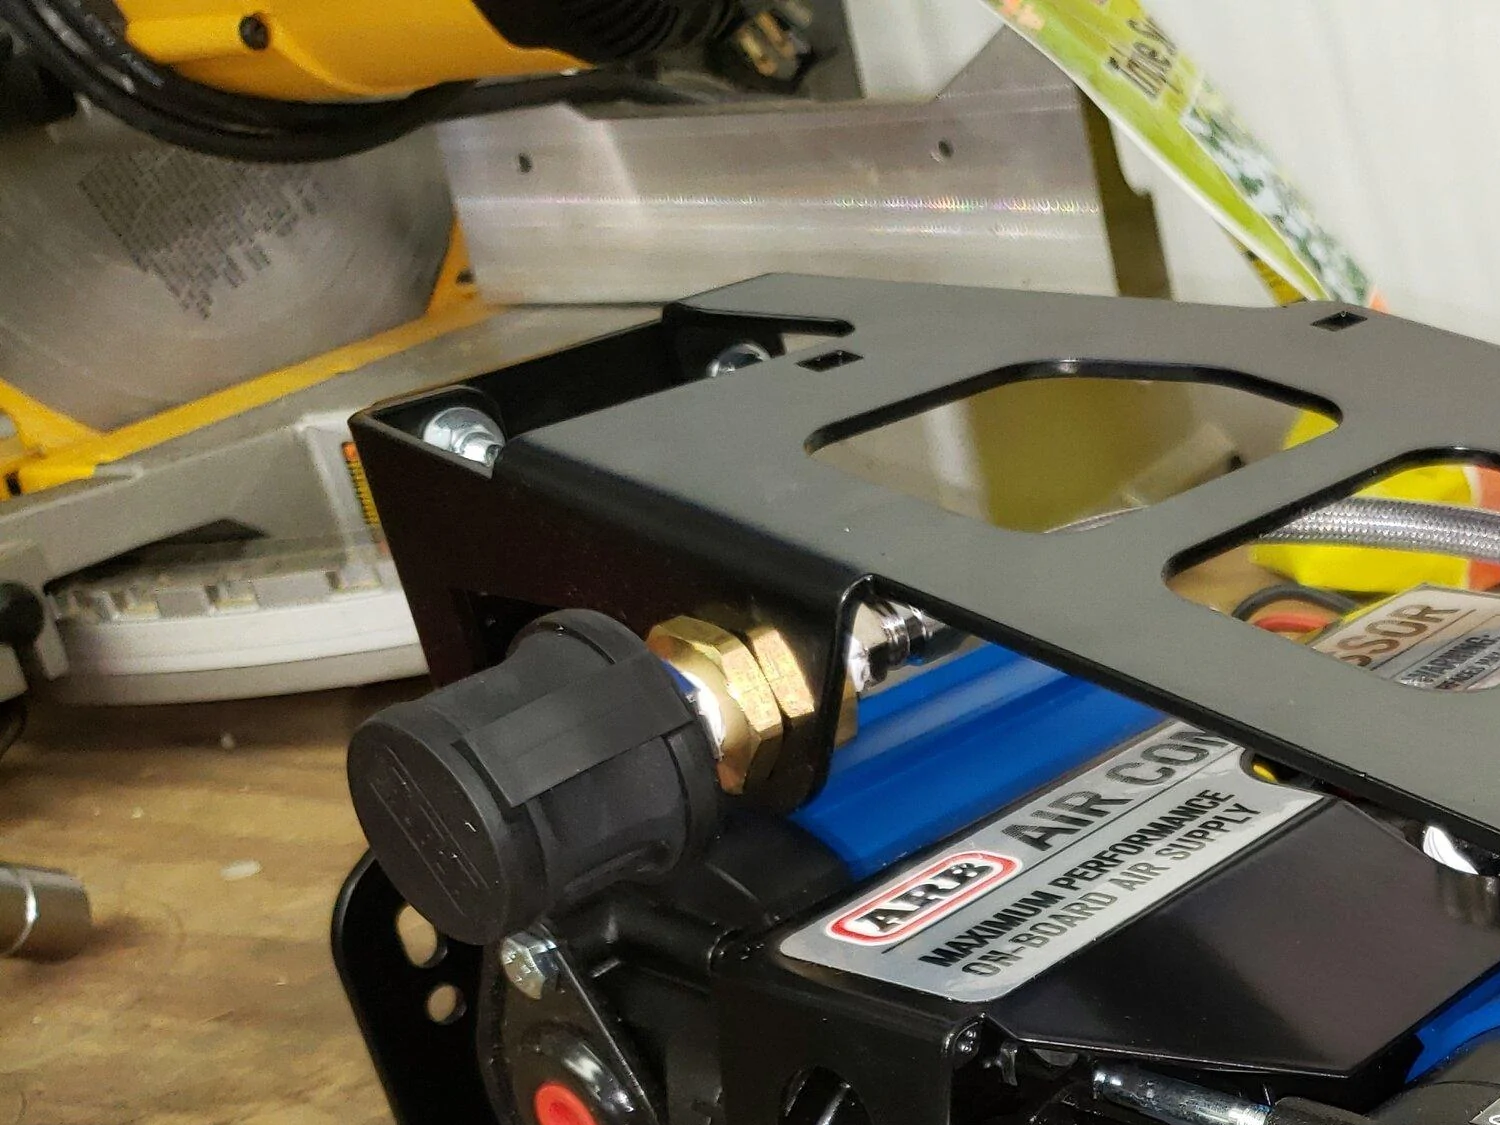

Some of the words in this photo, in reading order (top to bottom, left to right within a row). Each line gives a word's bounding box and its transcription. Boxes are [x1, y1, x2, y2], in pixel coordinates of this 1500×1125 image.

[918, 890, 1066, 968] MAXIMUM
[1047, 789, 1235, 891] PERFORMANCE
[1001, 790, 1135, 851] AIR
[855, 862, 993, 932] ARB
[961, 891, 1118, 976] ON-BOARD
[1109, 862, 1170, 892] AIR
[1155, 803, 1261, 861] SUPPLY
